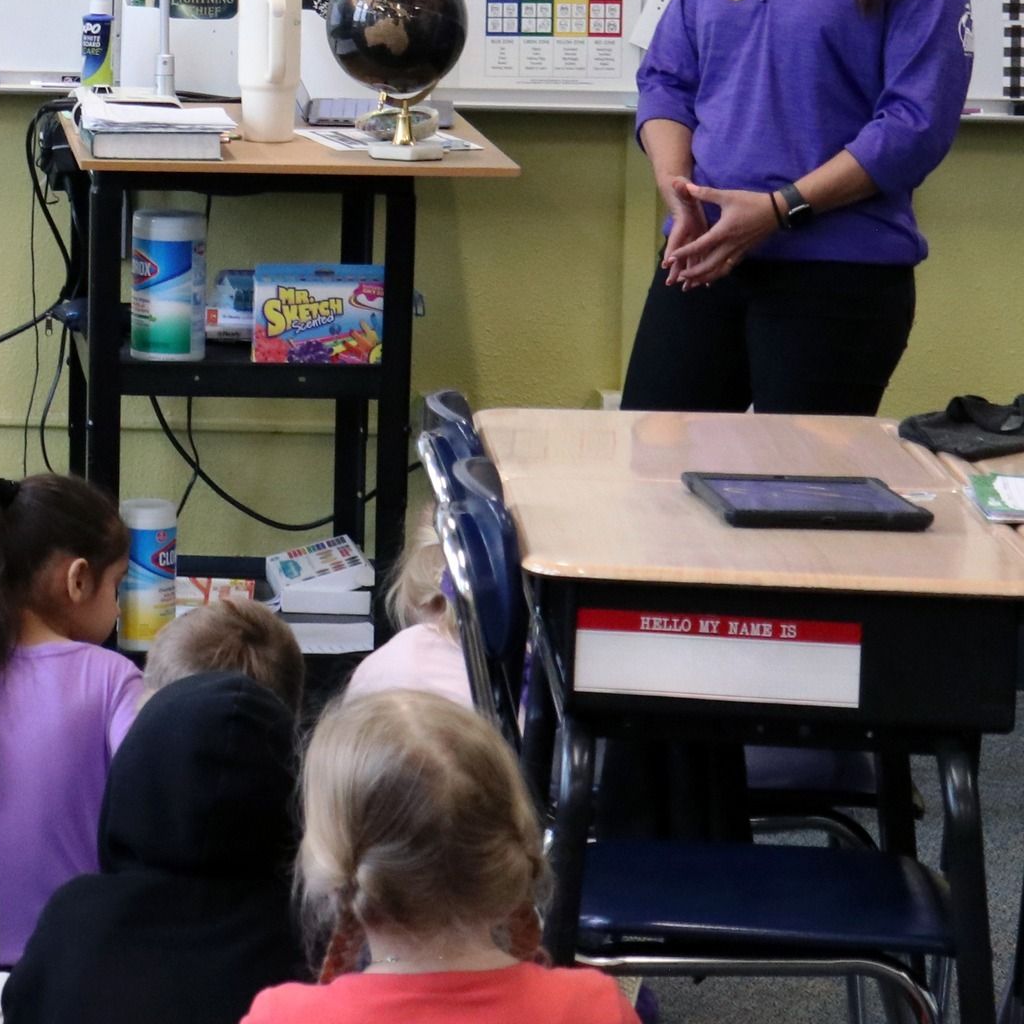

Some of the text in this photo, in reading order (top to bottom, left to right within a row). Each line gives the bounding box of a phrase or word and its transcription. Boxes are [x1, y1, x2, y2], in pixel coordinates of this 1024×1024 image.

[263, 298, 344, 337] SKETCH
[292, 312, 334, 334] Scented
[640, 616, 797, 639] HELLO MY NAME IS
